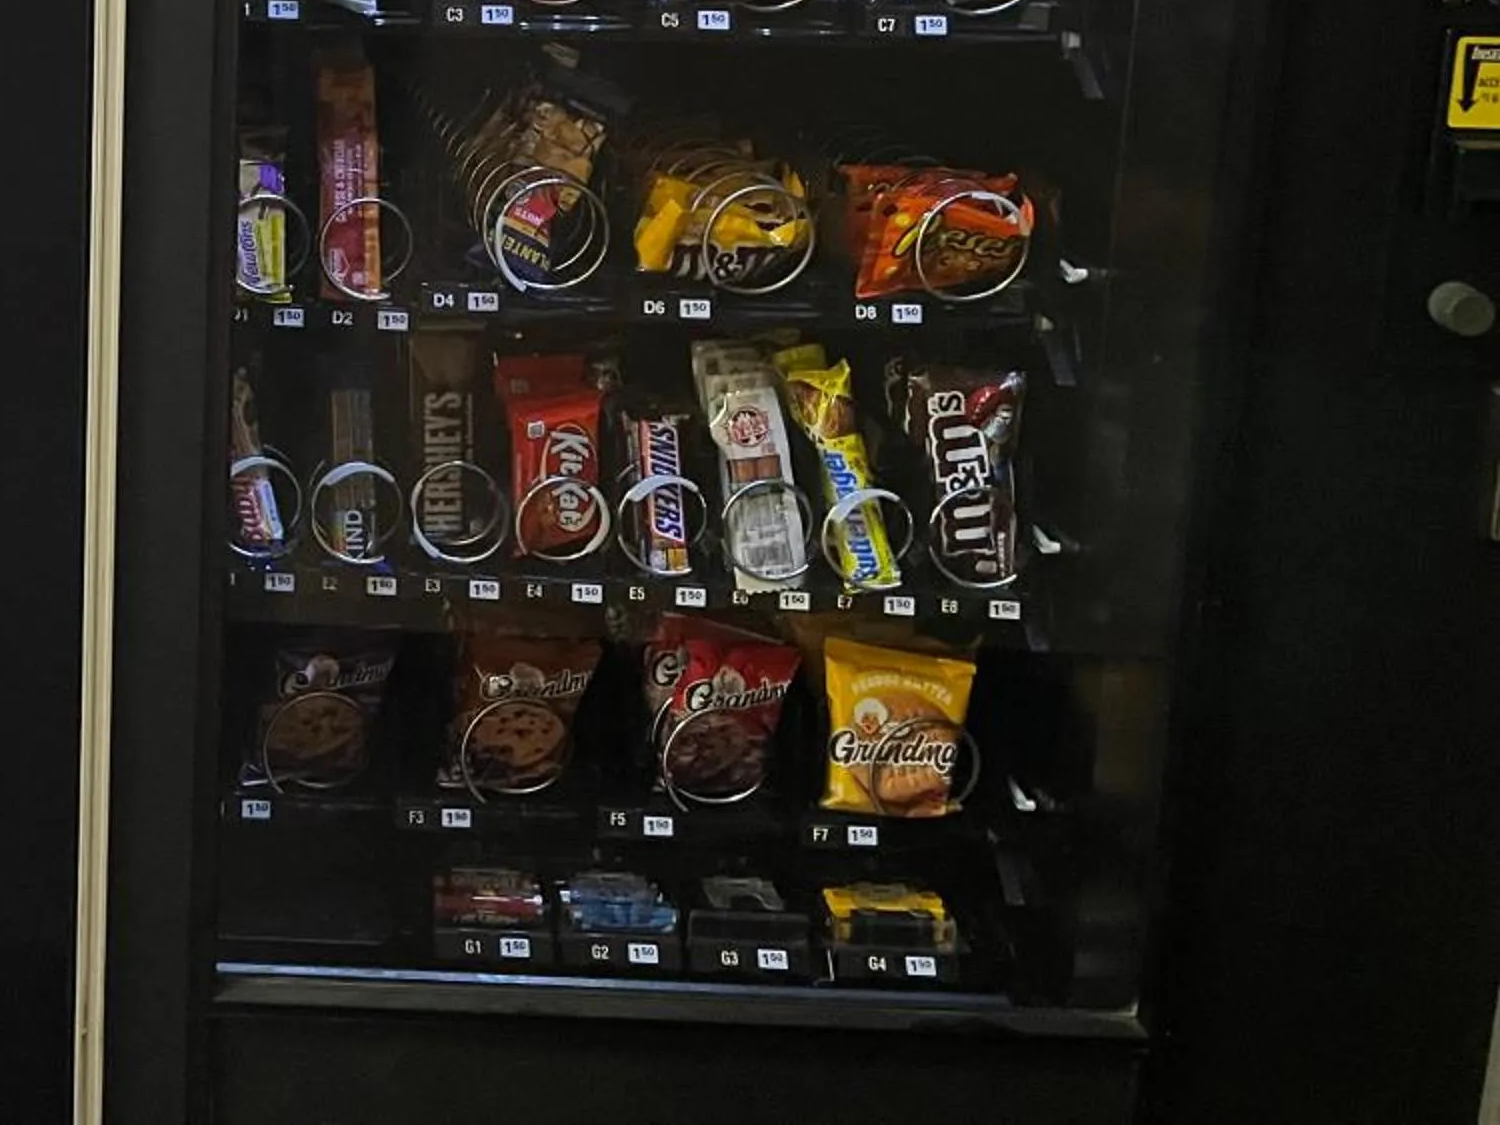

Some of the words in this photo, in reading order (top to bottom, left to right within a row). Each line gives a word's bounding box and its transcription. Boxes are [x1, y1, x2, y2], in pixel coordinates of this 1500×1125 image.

[447, 8, 464, 22] C3
[662, 13, 680, 27] C5
[878, 18, 896, 32] C7
[433, 294, 454, 307] D4
[644, 300, 665, 314] D6
[332, 312, 353, 324] D2
[855, 305, 877, 319] D8
[550, 430, 591, 478] Kit
[423, 392, 463, 536] HERSHEY'S
[552, 480, 590, 531] Kat
[629, 587, 645, 600] E5
[837, 595, 853, 609] E7
[410, 810, 425, 824] F3
[610, 812, 626, 826] F5
[813, 828, 829, 841] F7
[465, 940, 482, 955] G1
[591, 944, 610, 960] G2
[720, 950, 739, 966] G3
[867, 955, 887, 971] G4
